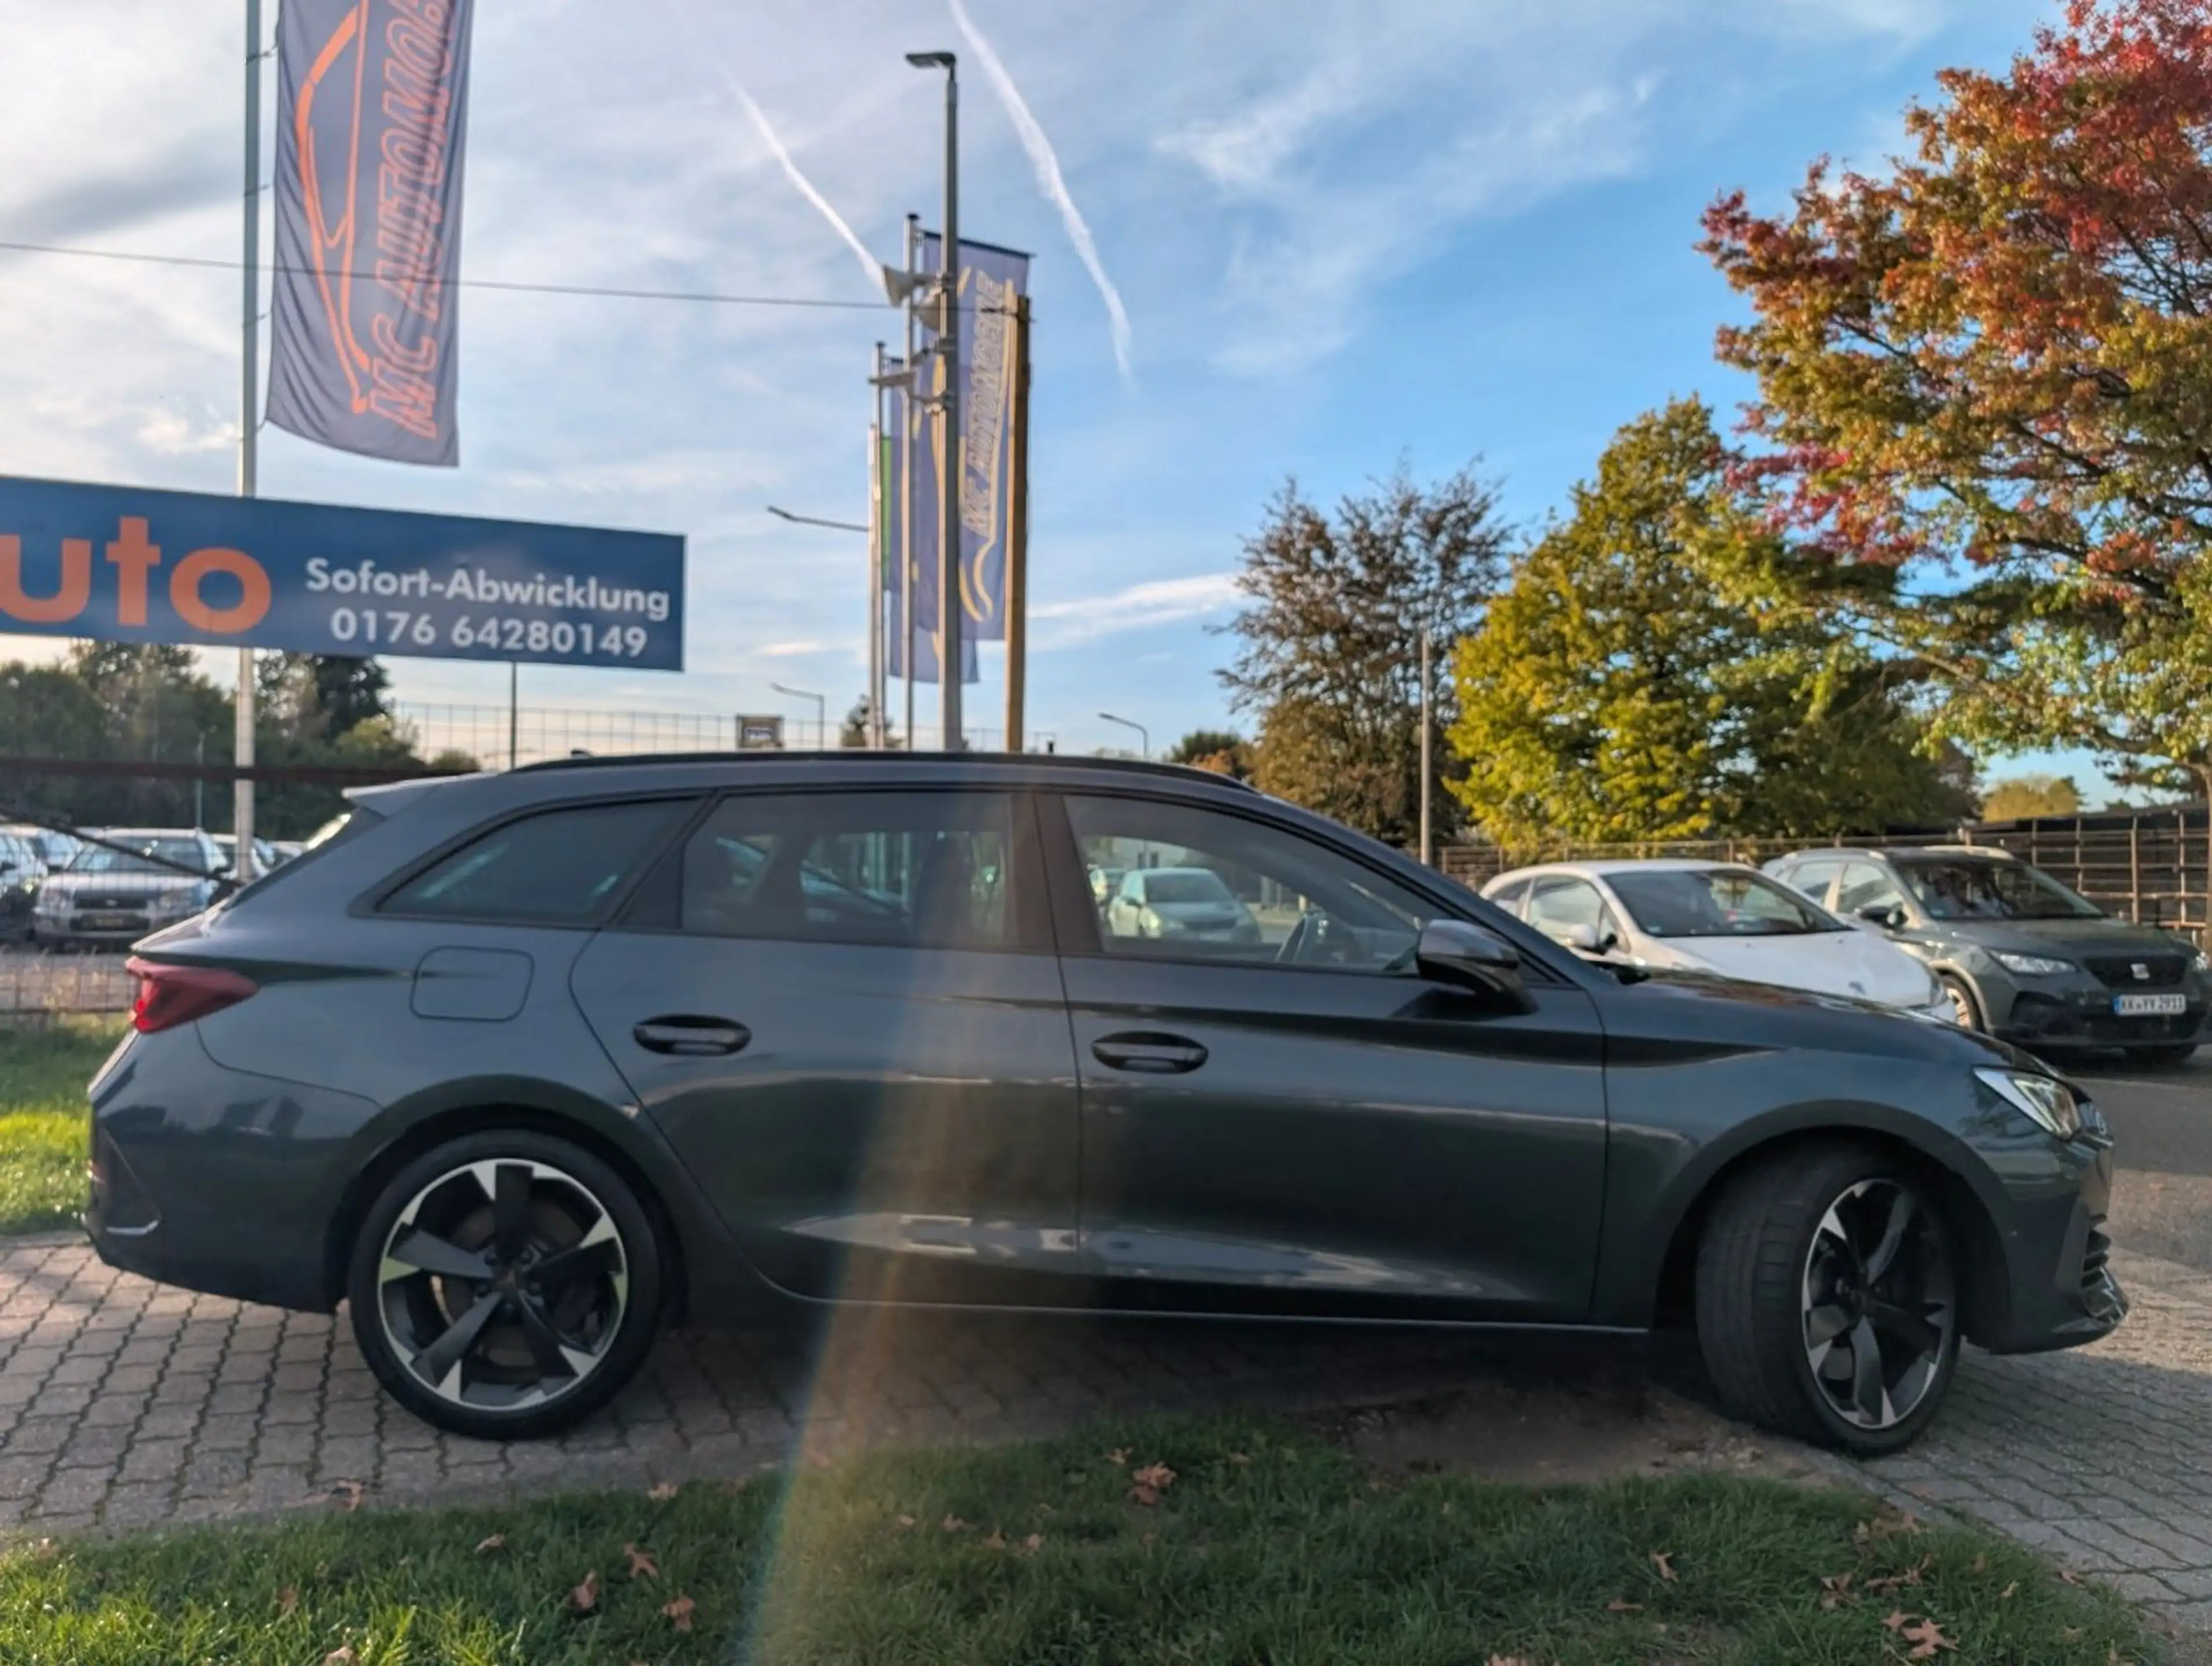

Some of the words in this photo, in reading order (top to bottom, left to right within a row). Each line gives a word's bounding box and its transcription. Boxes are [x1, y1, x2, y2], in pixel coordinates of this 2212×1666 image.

[369, 313, 439, 439] MC
[306, 557, 669, 621] Sofort-Abwicklung
[331, 608, 436, 645] 0176
[451, 616, 647, 657] 64280149
